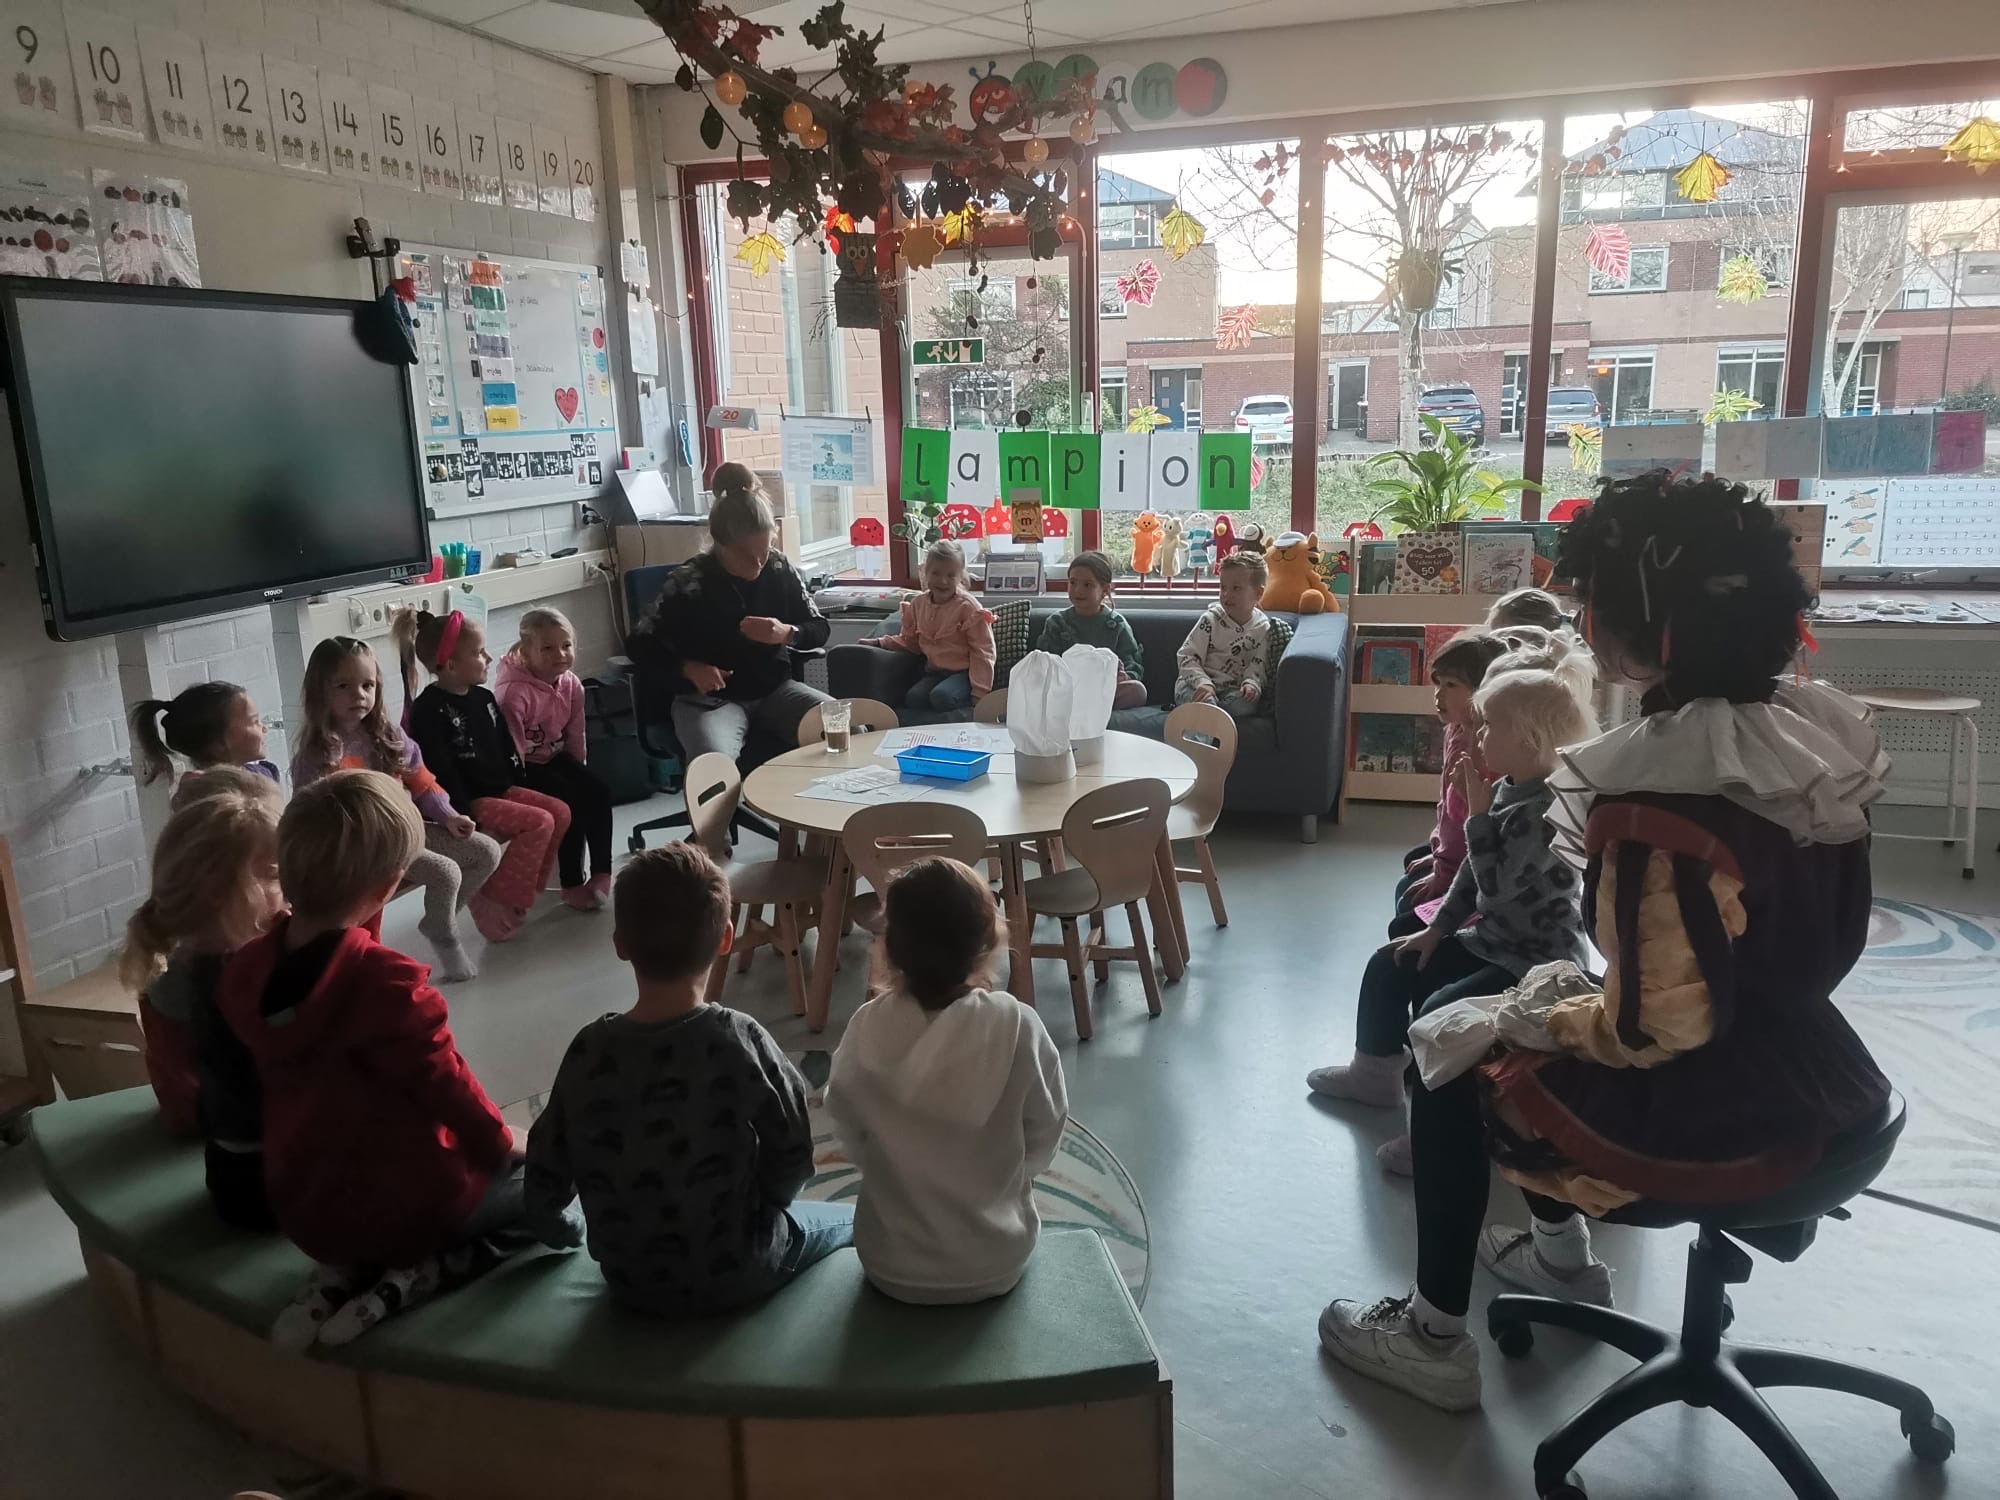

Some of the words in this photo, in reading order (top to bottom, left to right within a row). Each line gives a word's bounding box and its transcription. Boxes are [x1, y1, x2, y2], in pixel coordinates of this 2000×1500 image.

[16, 25, 39, 64] 9
[87, 41, 120, 84] 10
[165, 61, 183, 100] 11
[223, 74, 252, 114] 12
[281, 88, 307, 124] 13
[333, 101, 358, 136] 14
[382, 113, 404, 146] 15
[426, 124, 447, 156] 16
[469, 134, 485, 163] 17
[508, 143, 525, 171] 18
[544, 151, 558, 176] 19
[574, 159, 594, 186] 20
[722, 409, 740, 421] 20
[1421, 566, 1435, 576] 50
